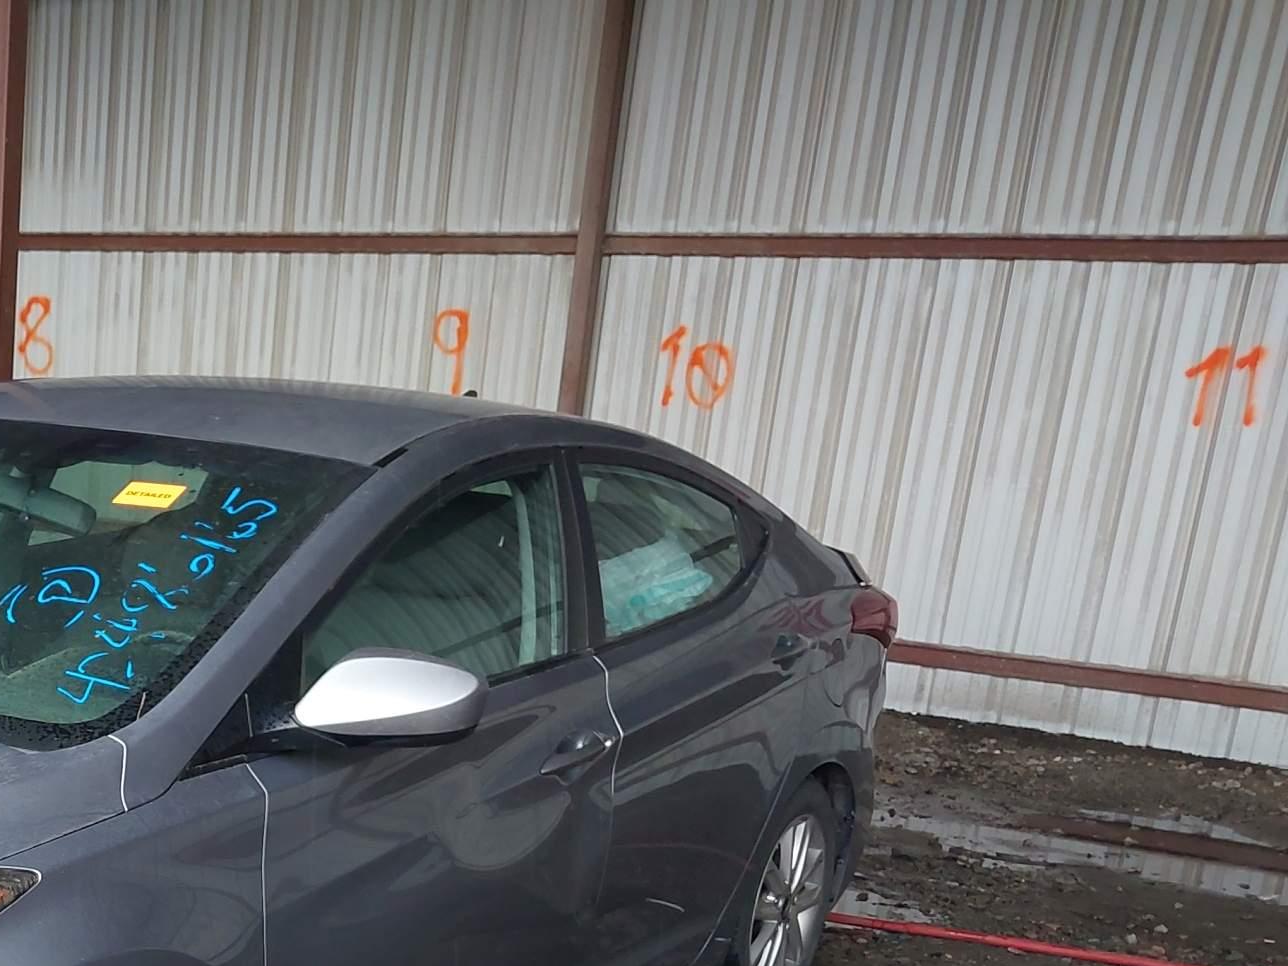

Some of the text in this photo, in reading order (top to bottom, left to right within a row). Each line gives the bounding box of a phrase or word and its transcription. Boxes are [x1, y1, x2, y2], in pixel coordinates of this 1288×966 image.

[16, 294, 54, 376] 8
[431, 308, 472, 397] 9
[659, 323, 735, 411] 10
[1184, 344, 1269, 429] 11
[125, 490, 173, 499] DETAILED
